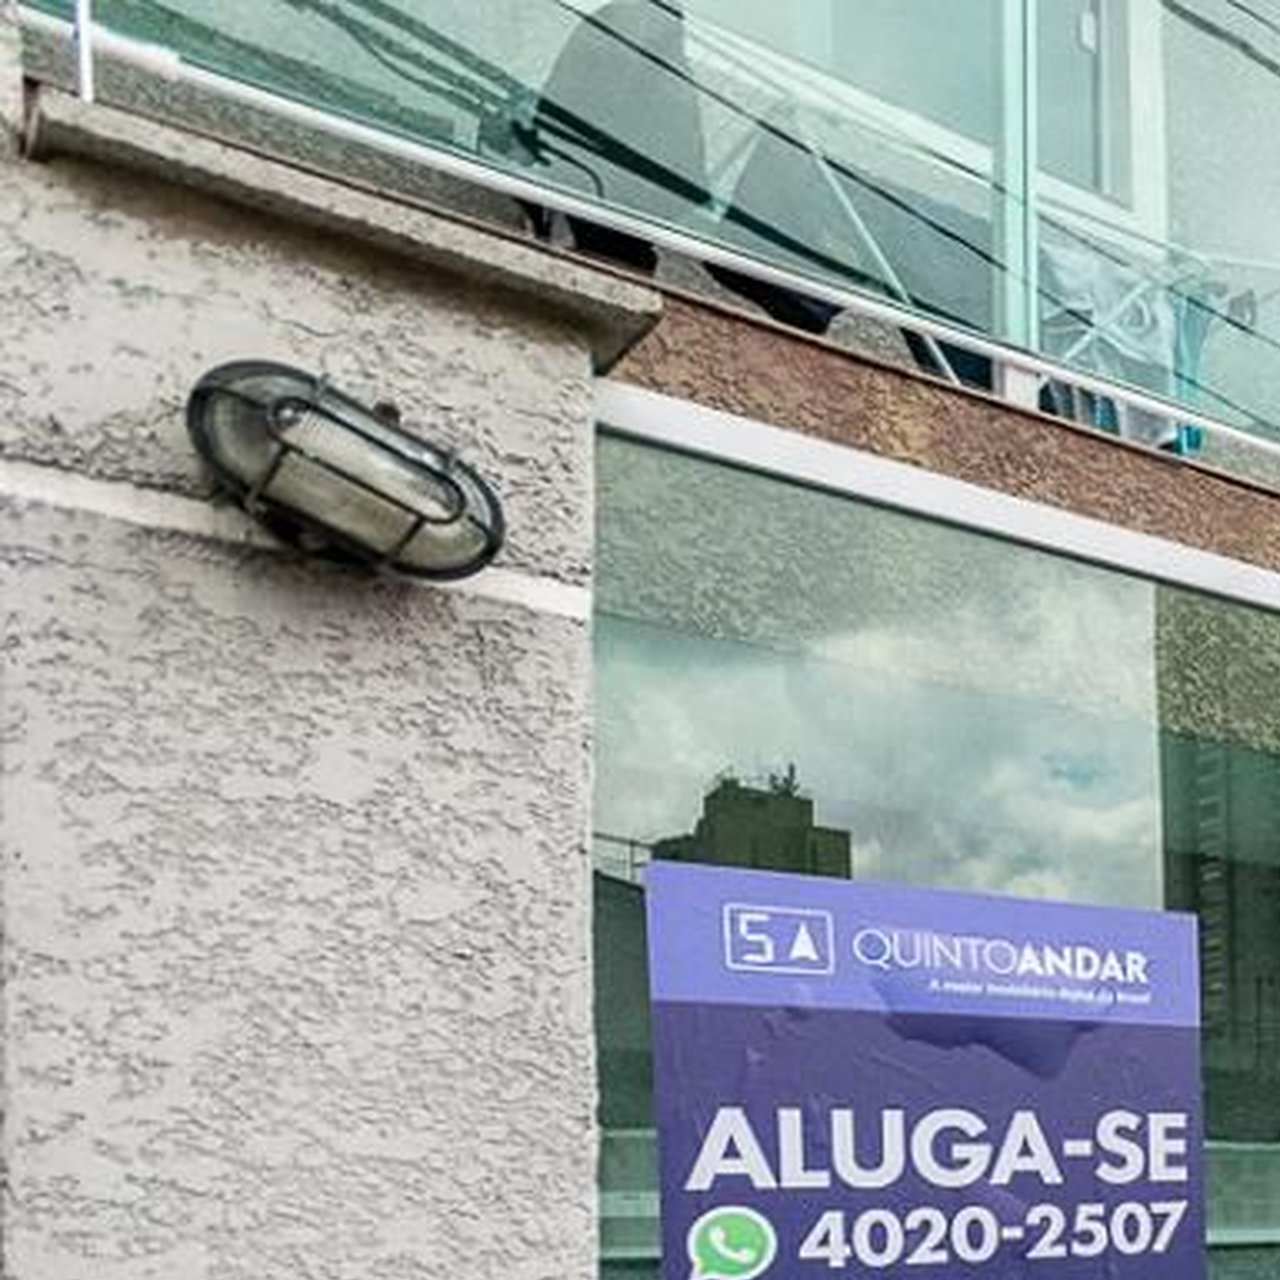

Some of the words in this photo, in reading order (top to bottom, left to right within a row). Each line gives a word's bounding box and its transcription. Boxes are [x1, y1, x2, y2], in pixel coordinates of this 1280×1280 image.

[853, 929, 1148, 984] QUINTOANDAR
[685, 1107, 1188, 1191] ALUGA-SE
[799, 1200, 1188, 1268] 4020-2507
